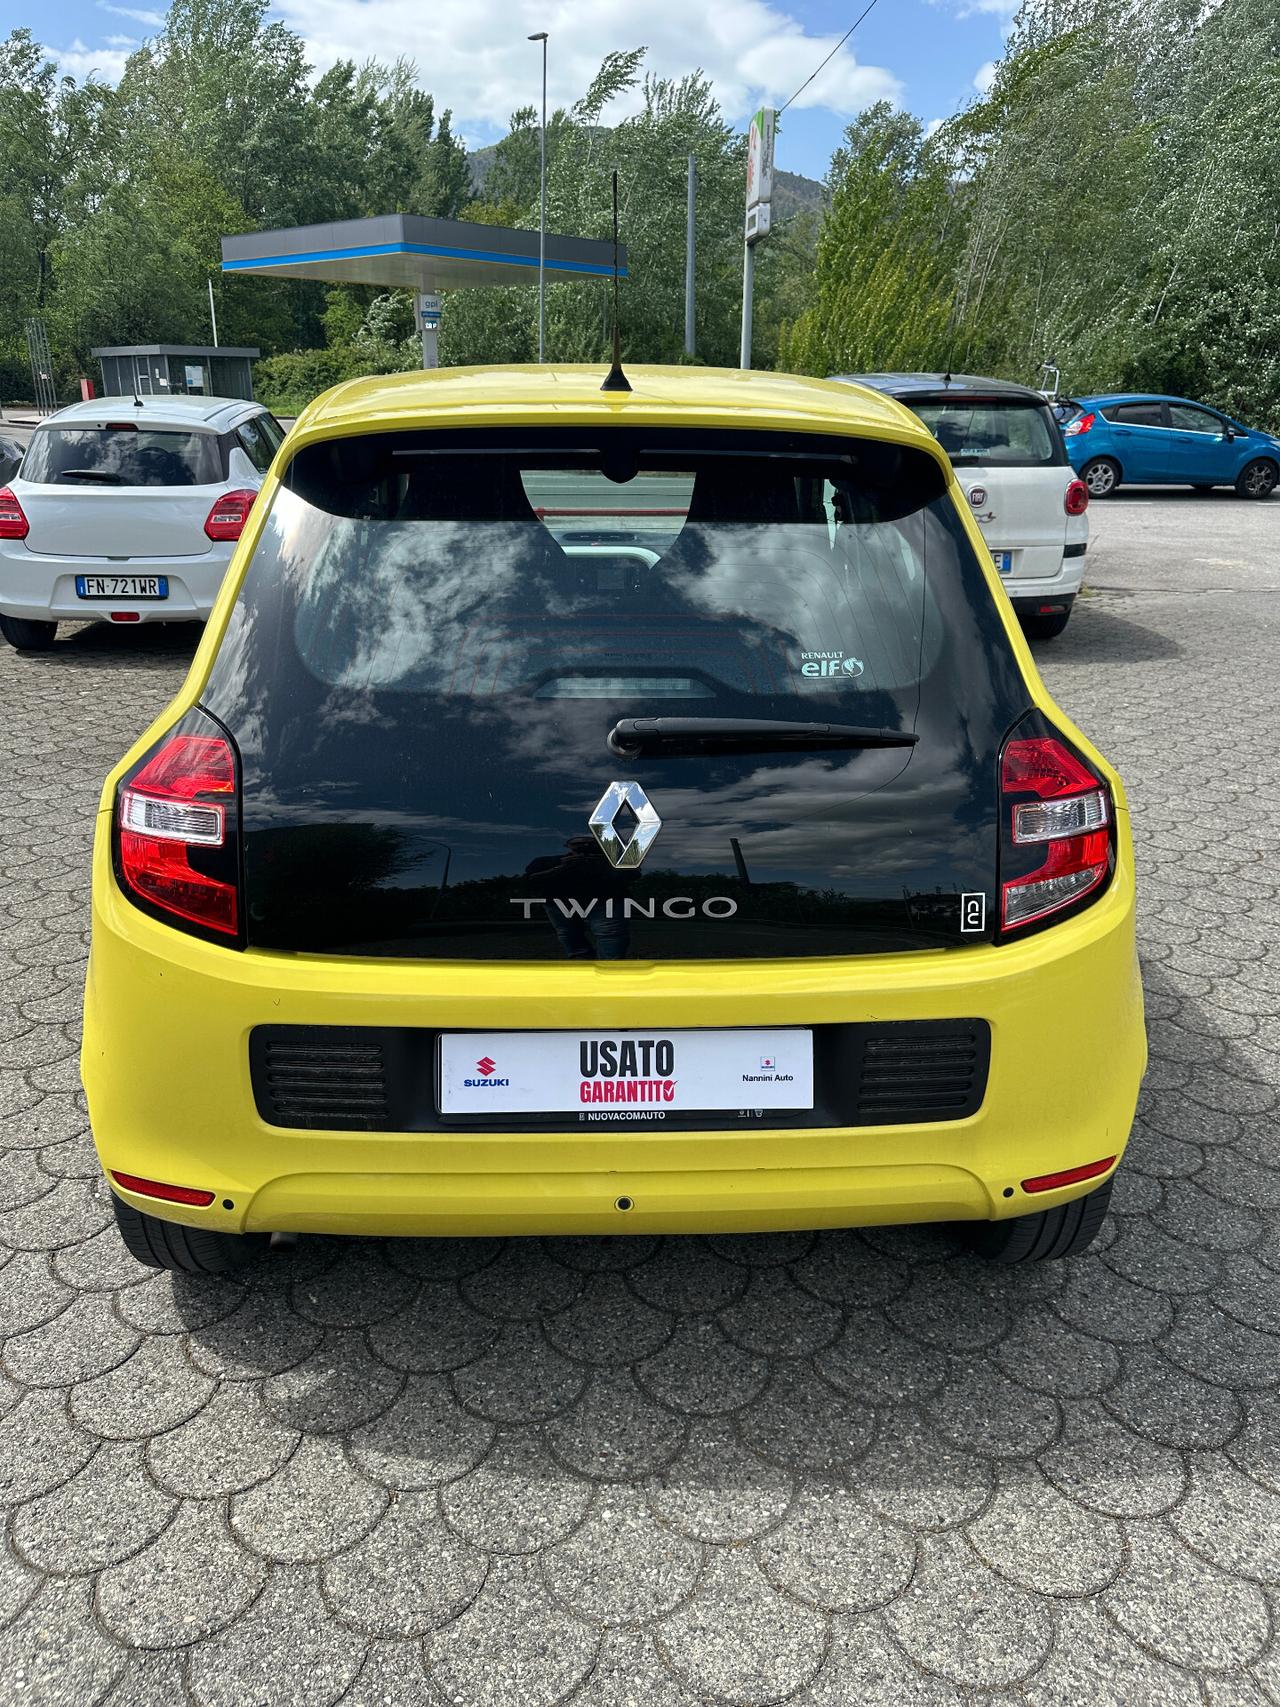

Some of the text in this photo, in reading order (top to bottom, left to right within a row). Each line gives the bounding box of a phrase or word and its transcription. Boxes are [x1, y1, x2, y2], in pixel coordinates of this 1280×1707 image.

[972, 492, 984, 502] FIAT
[801, 651, 843, 659] RENAULT
[801, 660, 840, 677] elf
[509, 896, 738, 919] TWINGO
[580, 1040, 675, 1078] USATO
[463, 1078, 509, 1087] SUZUKI
[742, 1074, 794, 1082] Nannini Auto
[580, 1080, 675, 1103] GARANTITO
[588, 1111, 666, 1121] NUOVACOMAUTO
